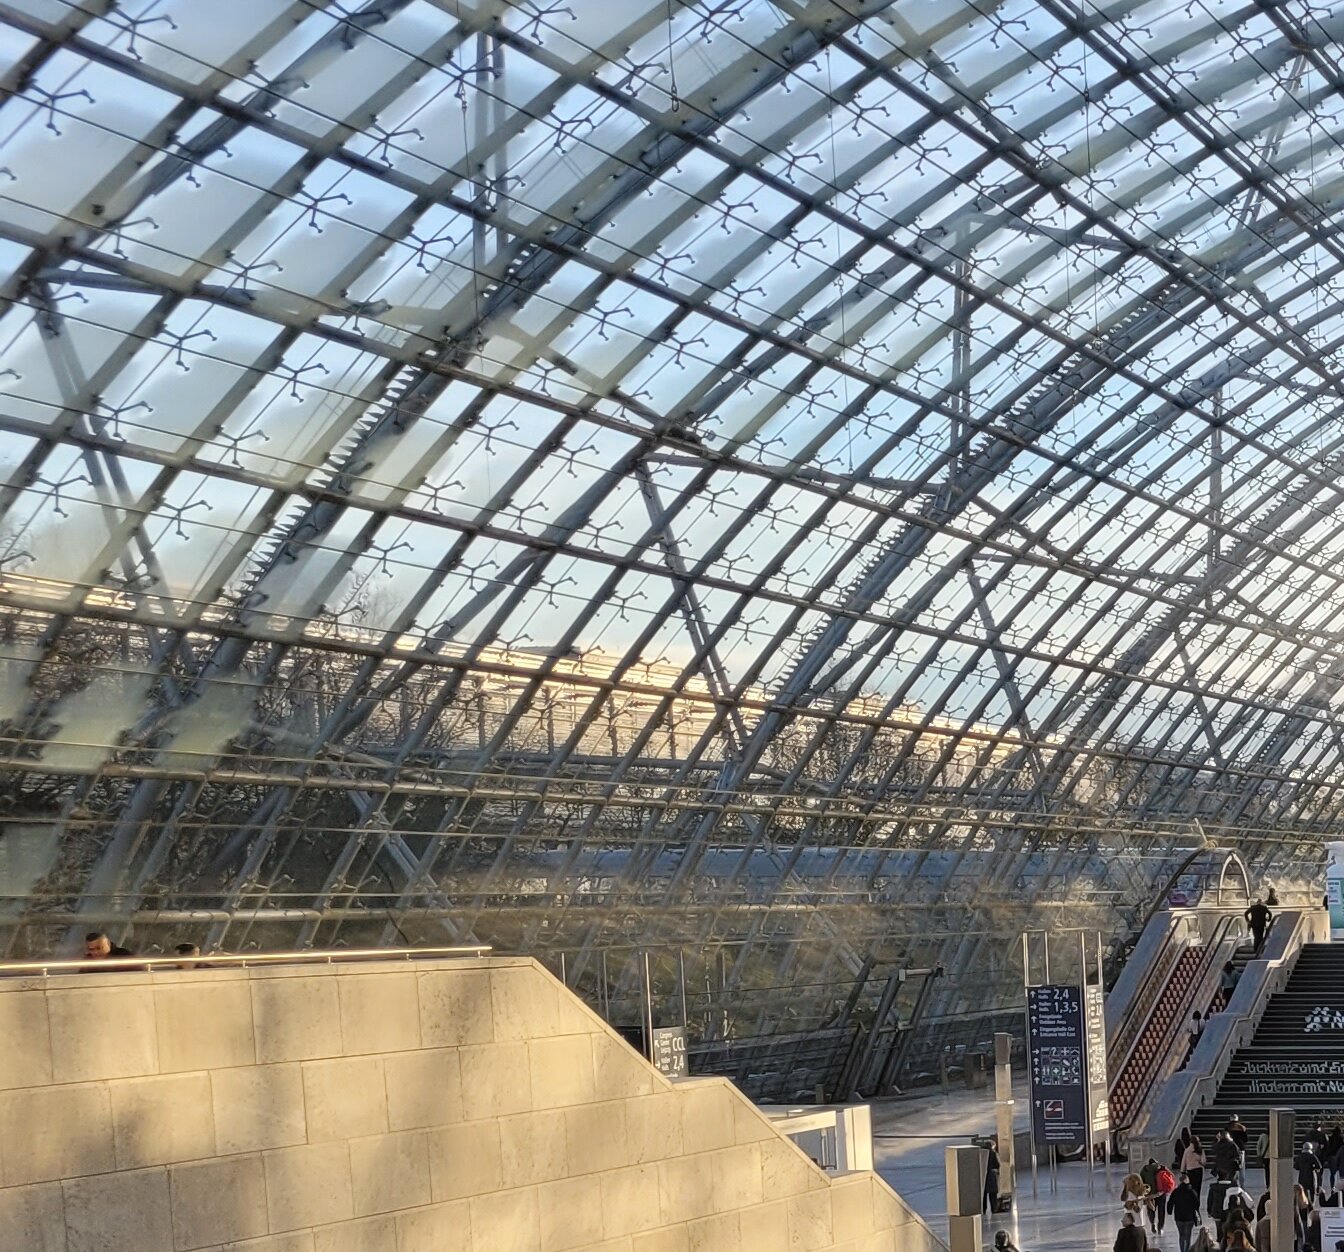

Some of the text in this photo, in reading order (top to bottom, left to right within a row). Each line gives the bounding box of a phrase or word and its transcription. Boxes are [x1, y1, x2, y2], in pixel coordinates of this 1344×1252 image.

[1053, 989, 1069, 1000] 2,4
[1054, 1001, 1078, 1013] 1,3,5
[1300, 1061, 1328, 1074] und
